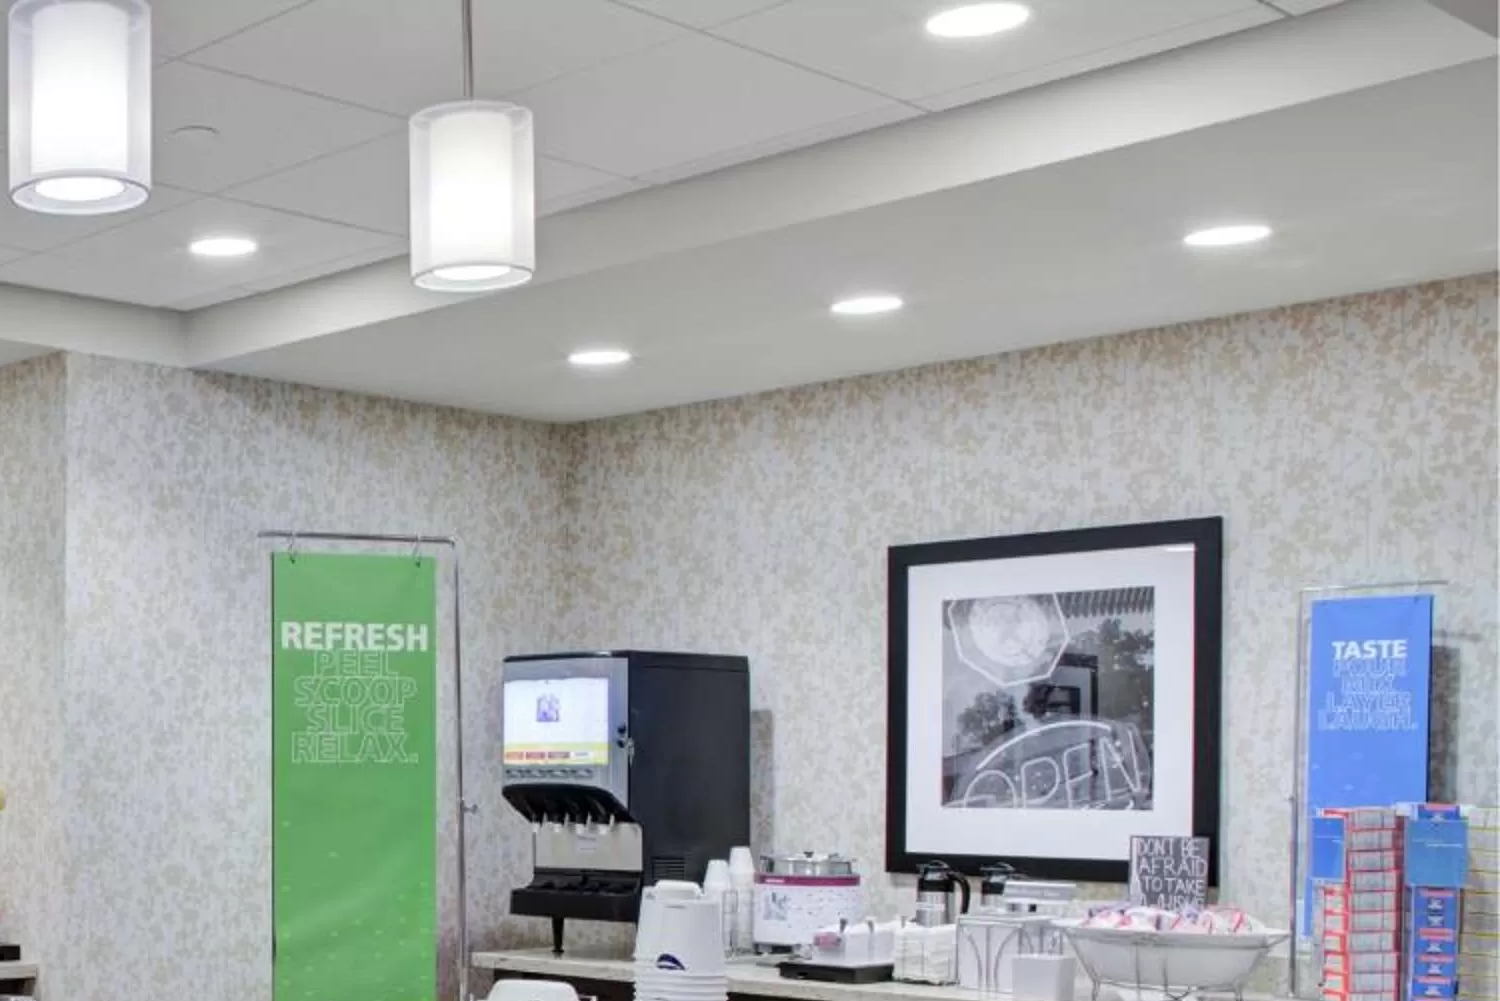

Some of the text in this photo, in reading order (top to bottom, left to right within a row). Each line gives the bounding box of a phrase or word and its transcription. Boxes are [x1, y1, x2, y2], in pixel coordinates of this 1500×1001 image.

[281, 621, 429, 651] REFRESH
[1331, 639, 1407, 660] TASTE
[314, 648, 399, 676] PEEL
[293, 675, 418, 706] SCOOP
[306, 703, 405, 734] SLICE
[291, 731, 420, 764] RELAX.
[1139, 856, 1207, 876] AFRAID
[1142, 876, 1162, 893] TO
